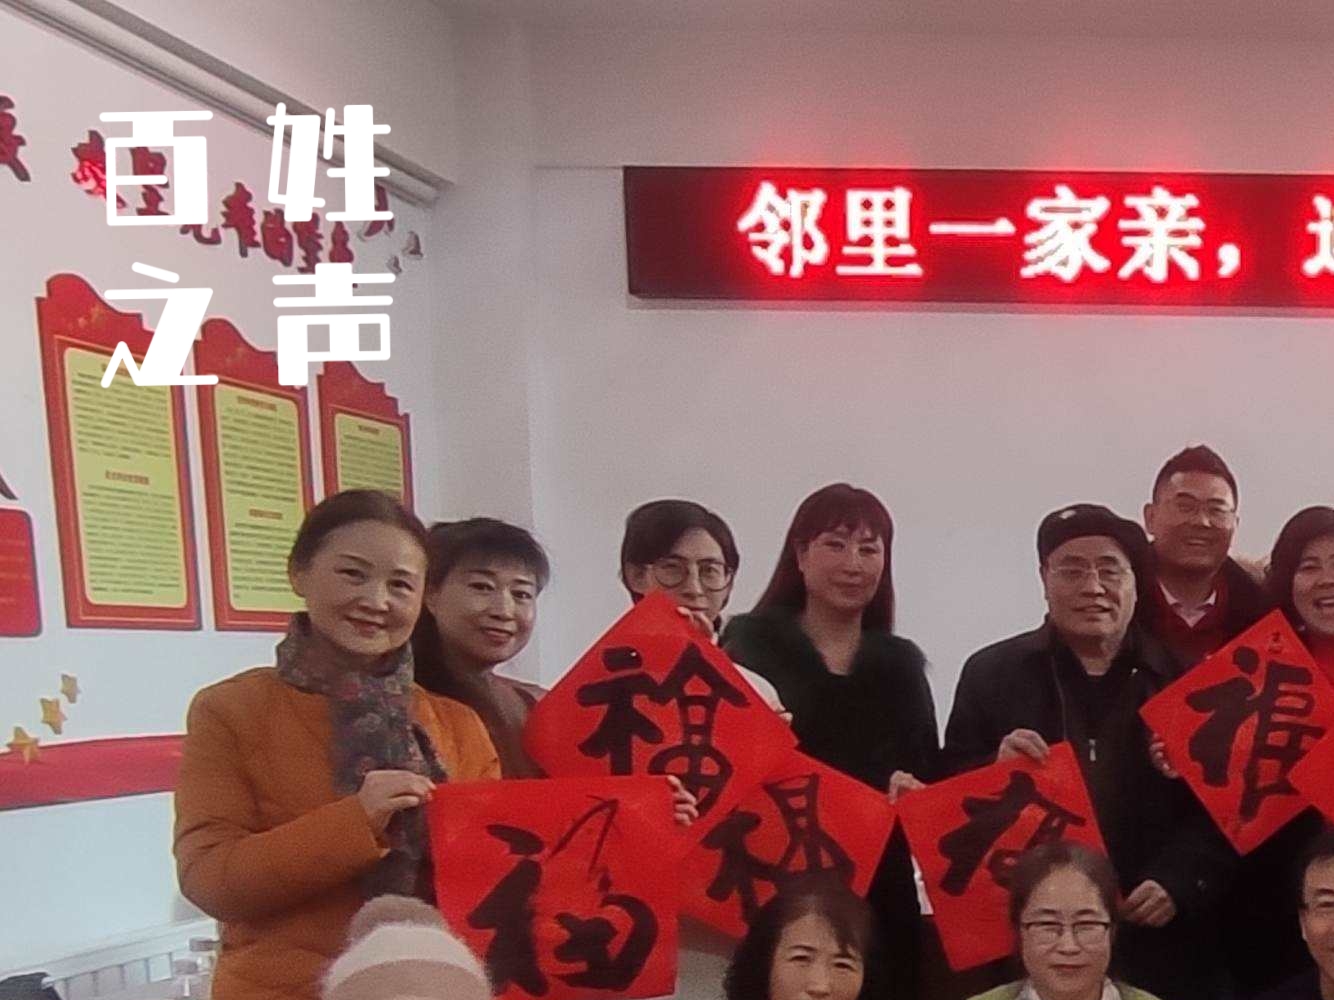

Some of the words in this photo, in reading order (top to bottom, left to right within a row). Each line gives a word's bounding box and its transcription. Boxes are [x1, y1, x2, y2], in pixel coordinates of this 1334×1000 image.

[577, 642, 750, 816] 福
[1186, 646, 1326, 821] 福
[468, 796, 659, 996] 福
